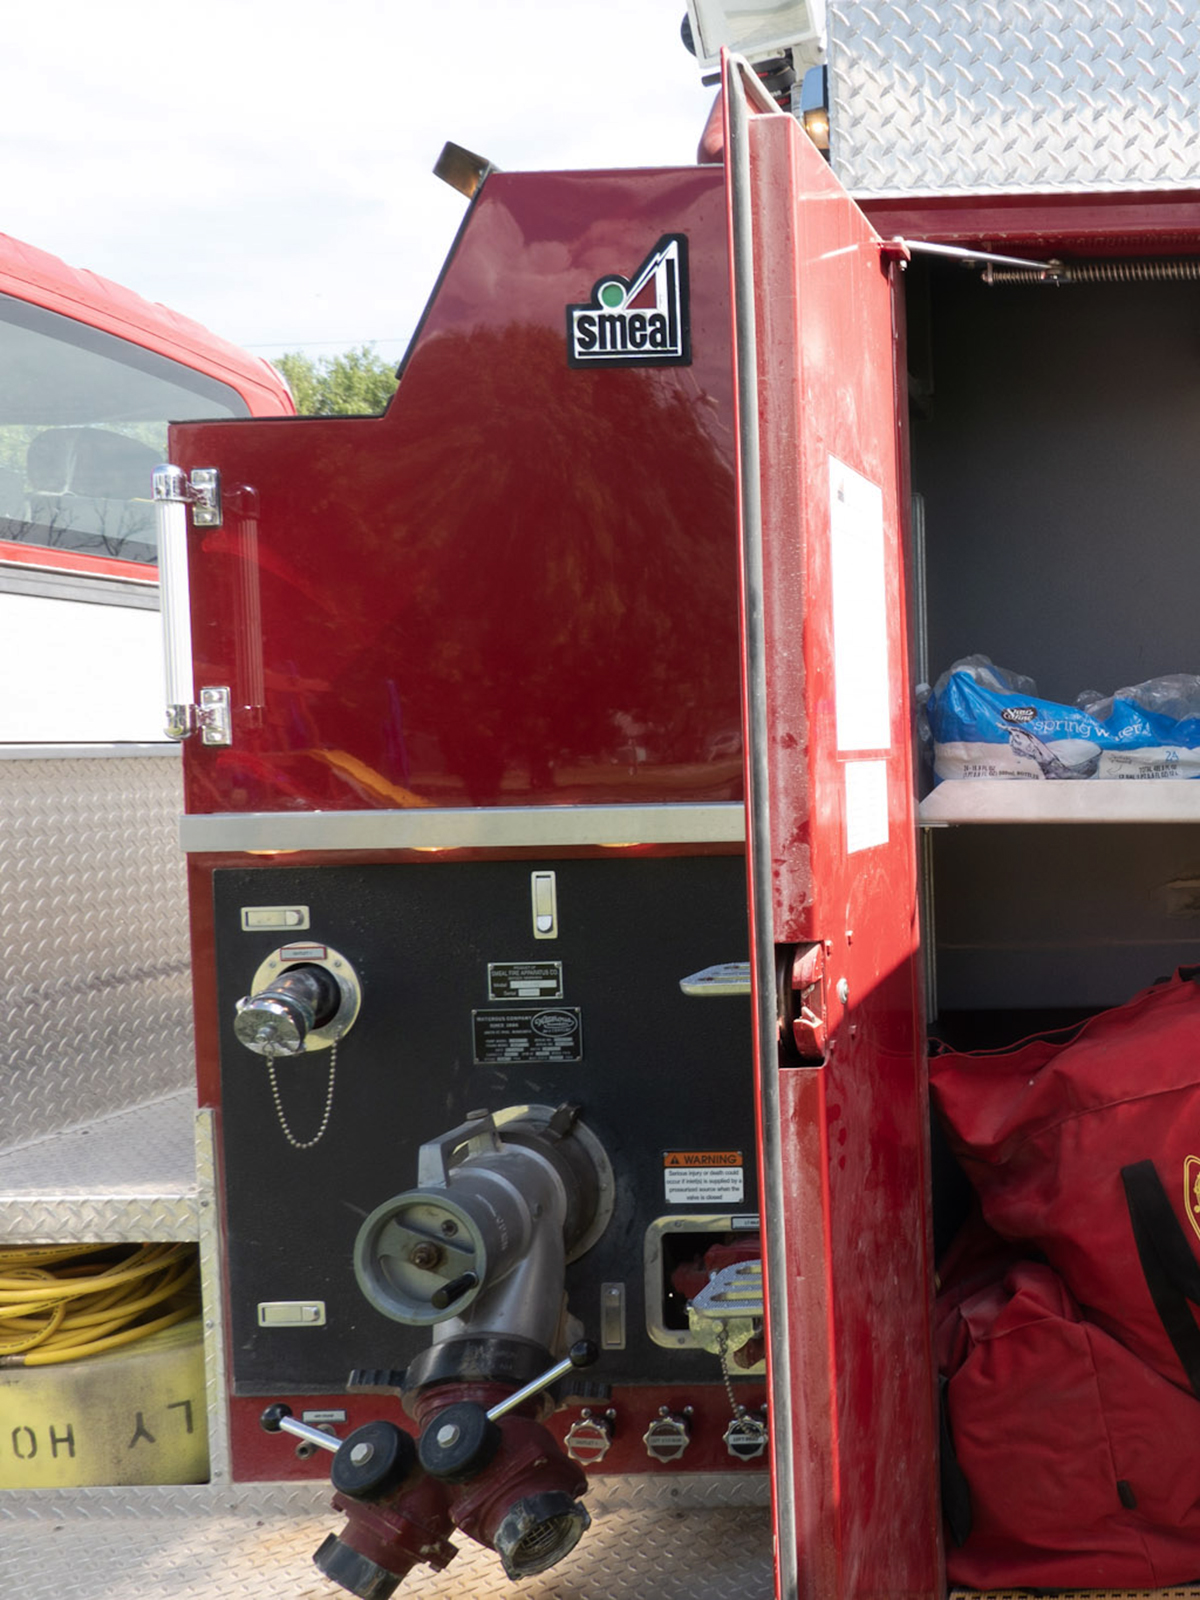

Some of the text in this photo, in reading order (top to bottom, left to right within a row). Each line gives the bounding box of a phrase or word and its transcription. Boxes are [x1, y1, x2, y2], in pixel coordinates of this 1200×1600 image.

[577, 258, 678, 350] smeal
[1034, 716, 1092, 738] spring
[684, 1154, 737, 1165] WARNING
